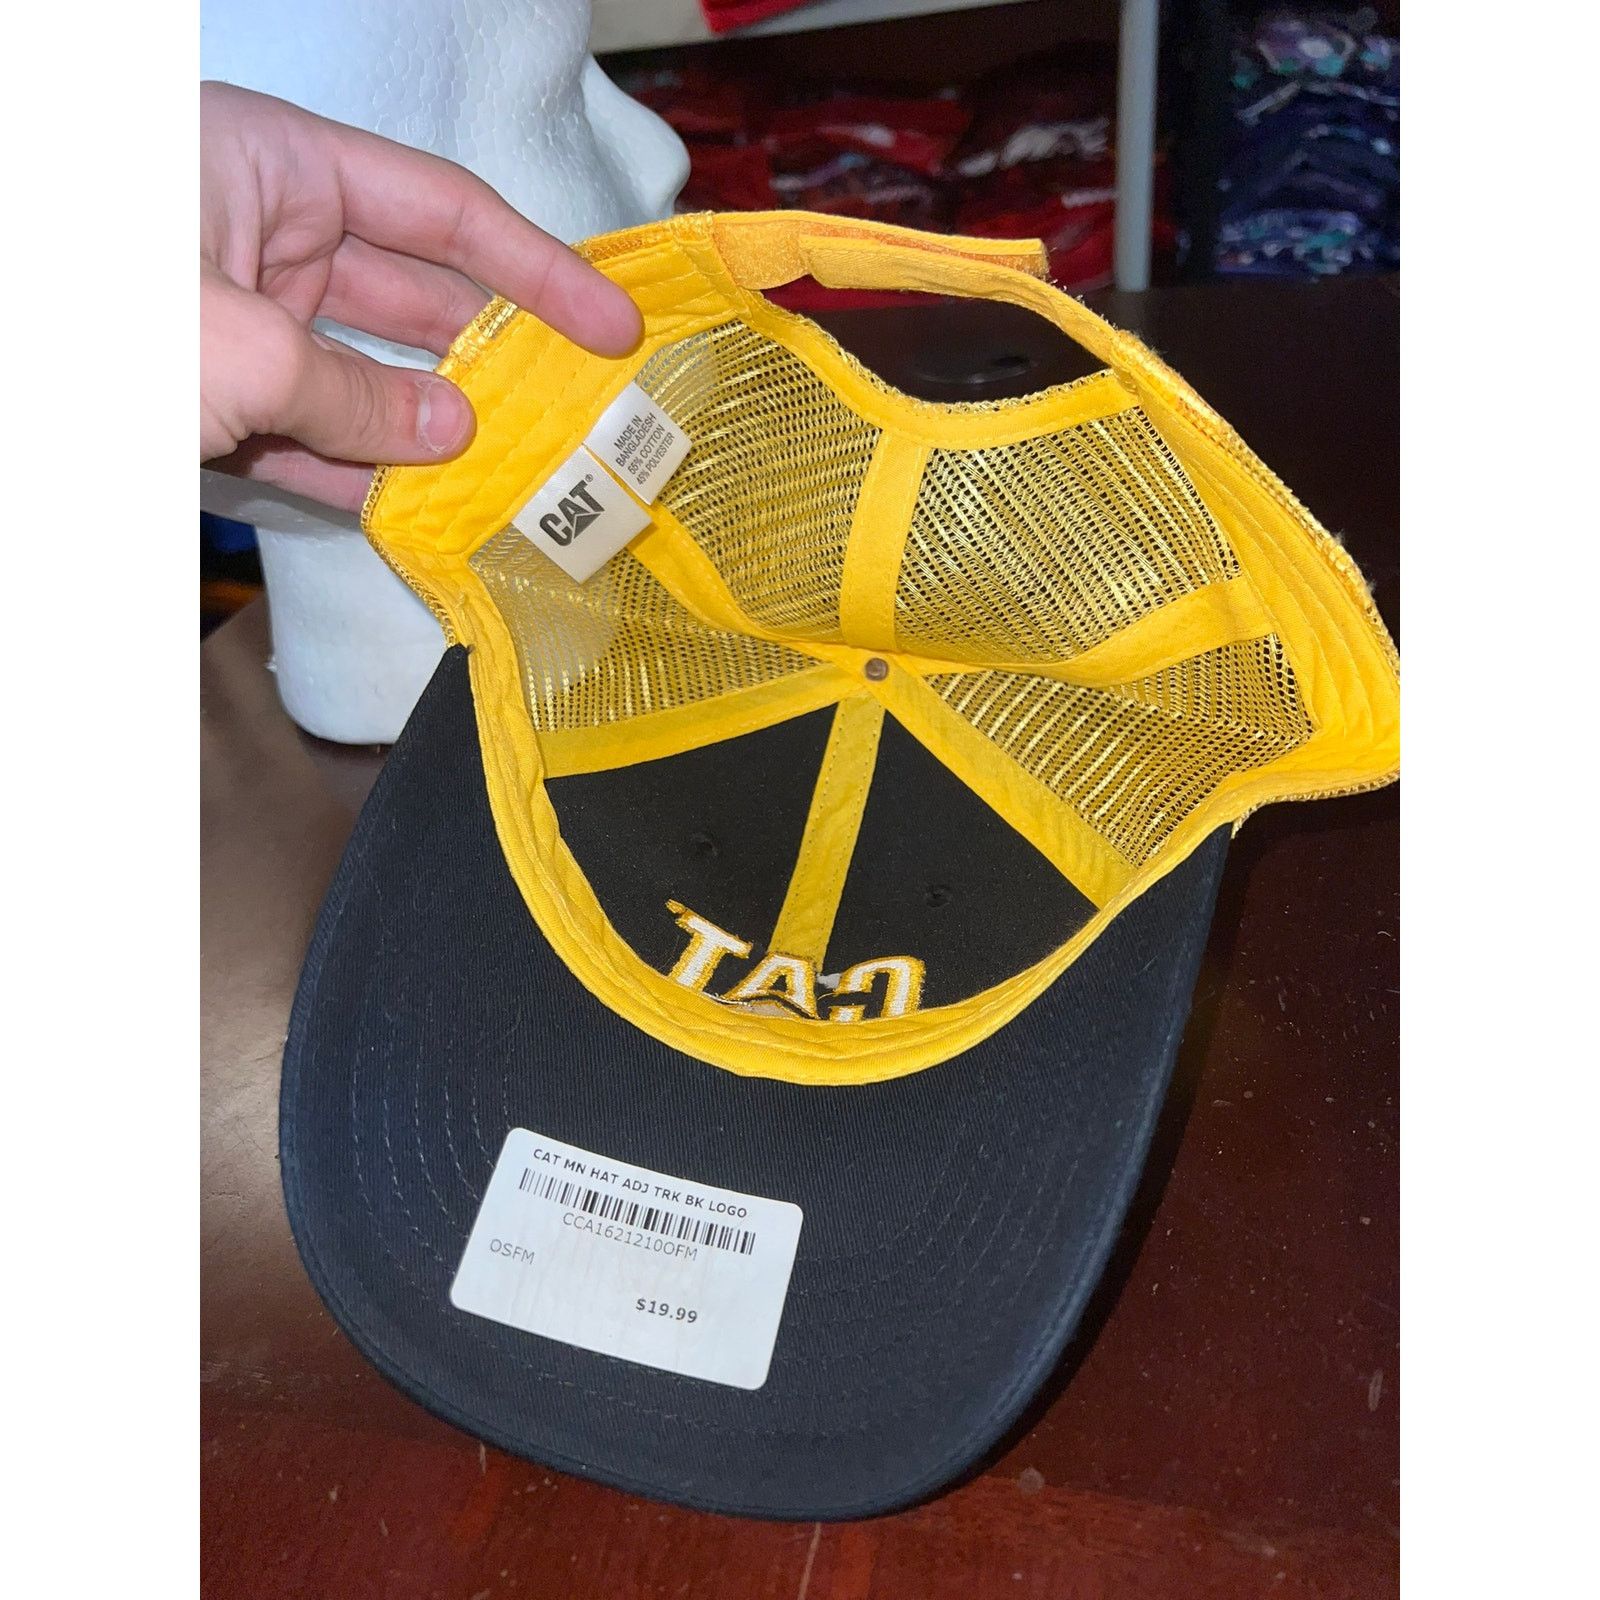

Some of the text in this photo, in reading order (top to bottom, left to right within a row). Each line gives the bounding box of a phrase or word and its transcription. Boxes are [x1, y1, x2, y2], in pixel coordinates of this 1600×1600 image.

[614, 415, 643, 451] MADE IN
[615, 412, 656, 467] BANGLADESH
[639, 424, 665, 458] COTTON
[637, 432, 675, 486] 45% POLYESTER
[533, 1149, 747, 1218] CAT MN HAT ADJ TRK BK LOGO
[489, 1238, 535, 1265] OSFM
[636, 1298, 698, 1324] $19.99
